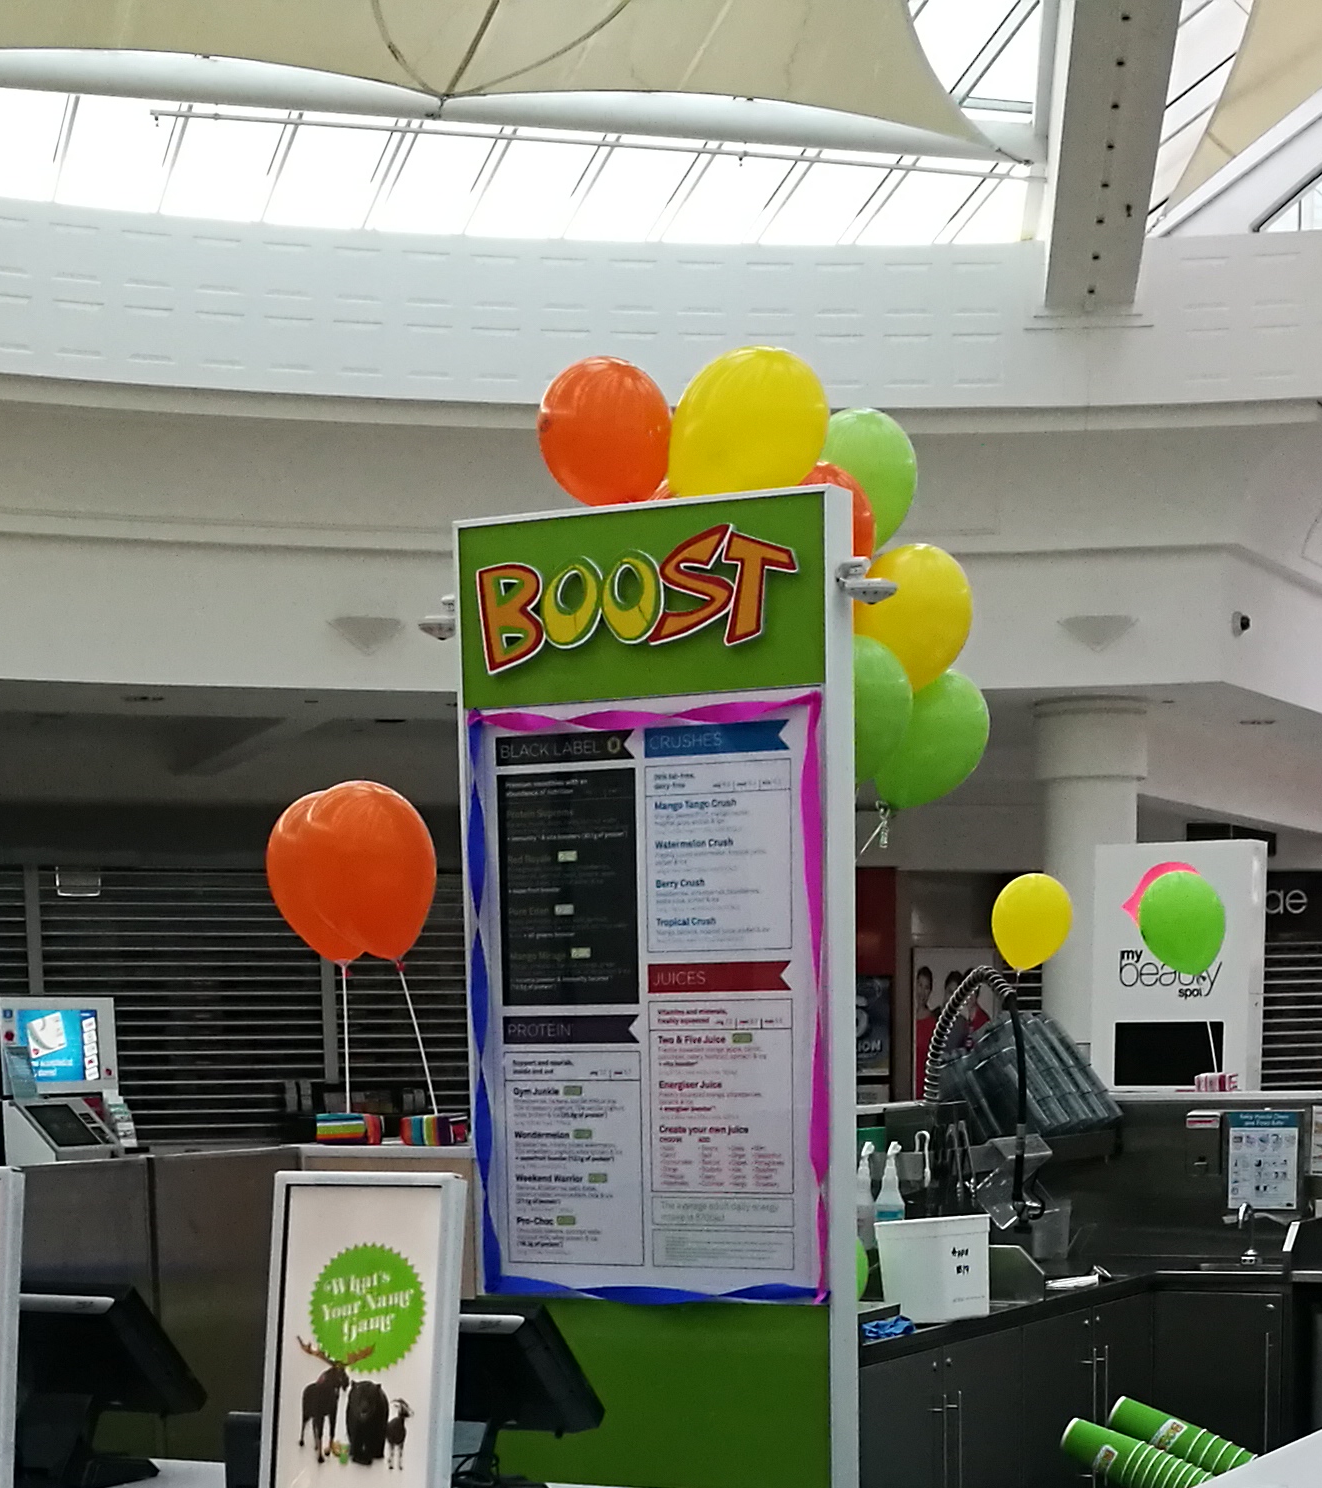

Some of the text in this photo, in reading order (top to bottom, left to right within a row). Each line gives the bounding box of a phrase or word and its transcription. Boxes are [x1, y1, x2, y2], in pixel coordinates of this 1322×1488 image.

[476, 524, 798, 676] BOOST
[649, 732, 723, 750] CRUSHES
[500, 740, 601, 759] BLACK LABEL
[654, 799, 737, 811] Mango Tango Crush
[655, 838, 734, 849] Watermelon Crush
[656, 878, 705, 889] Berry Crush
[656, 917, 717, 928] Tropical Crush
[1120, 949, 1143, 962] my
[653, 971, 706, 986] JUICES
[1119, 951, 1223, 997] beauy
[658, 1035, 675, 1044] Two
[684, 1035, 702, 1044] Five
[703, 1035, 726, 1044] Juice
[659, 1080, 722, 1091] Energiser Juice
[513, 1087, 559, 1097] Gym Junkie
[514, 1130, 570, 1139] Wondermelon
[659, 1125, 749, 1136] Create your own juice
[515, 1174, 583, 1183] Weekend Warrior
[517, 1216, 554, 1226] Pro-Choc
[323, 1270, 391, 1296] What's
[321, 1288, 414, 1322] Your Name
[342, 1313, 396, 1343] Game
